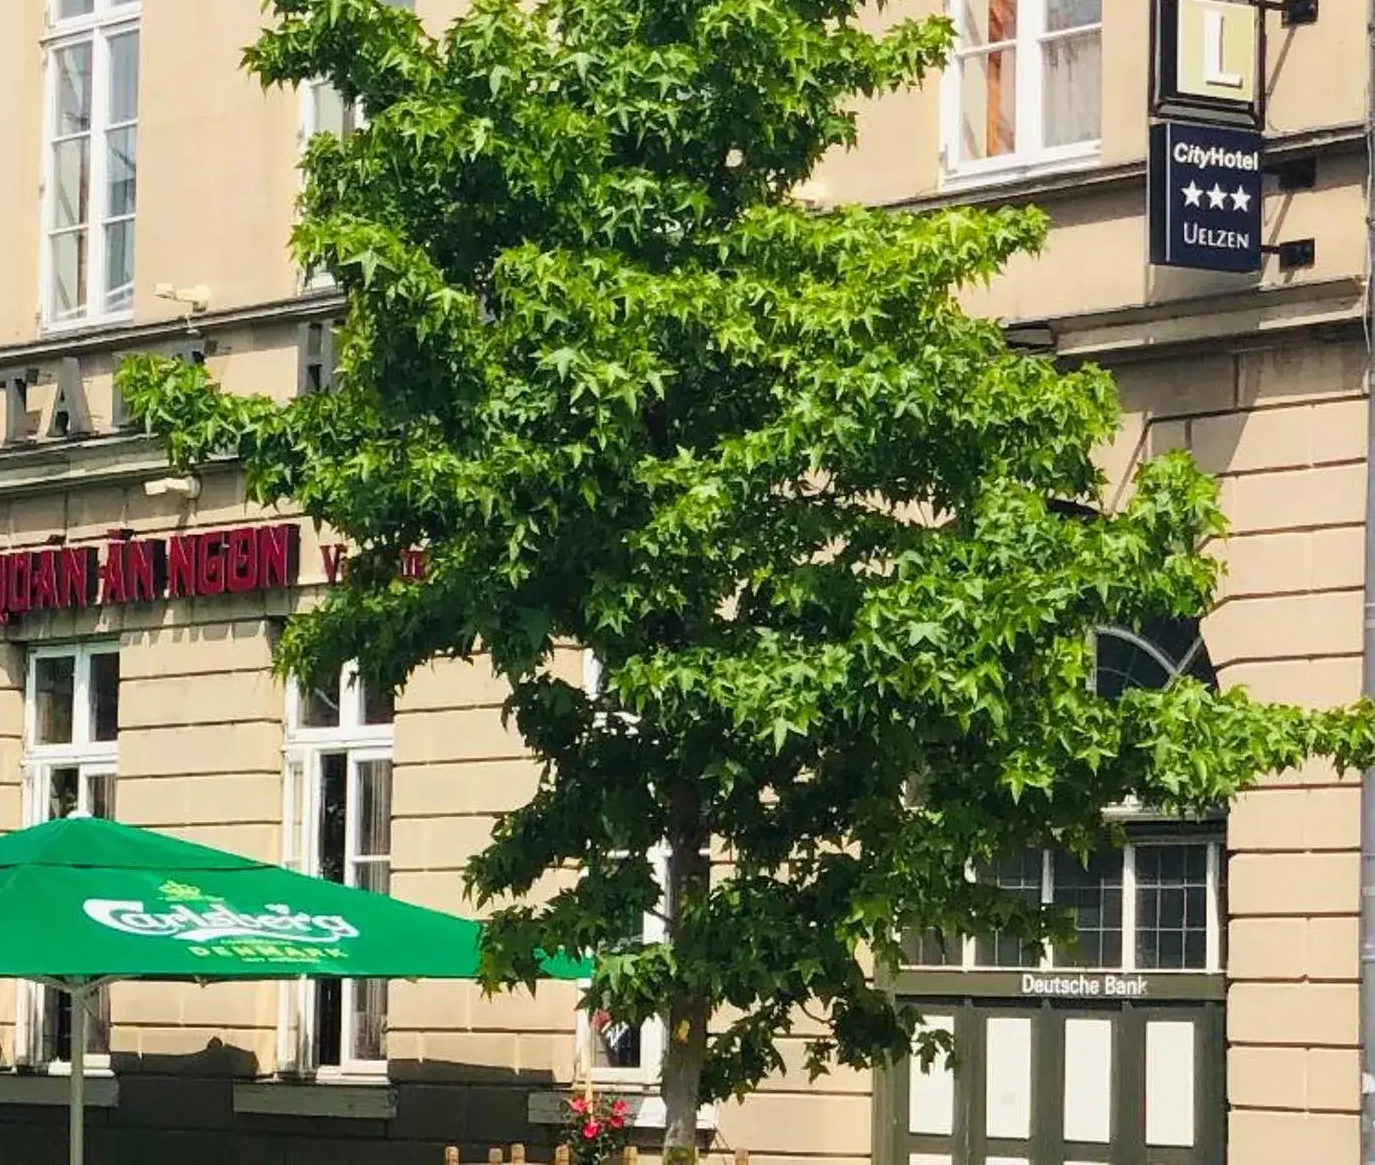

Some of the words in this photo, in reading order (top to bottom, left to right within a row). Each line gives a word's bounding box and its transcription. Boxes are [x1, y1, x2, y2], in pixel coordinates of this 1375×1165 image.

[1173, 142, 1259, 171] CityHotel
[1183, 221, 1250, 249] UELZEN
[82, 898, 360, 943] Carlsberg
[1022, 973, 1100, 995] Deutsche
[1105, 974, 1149, 996] Bank
